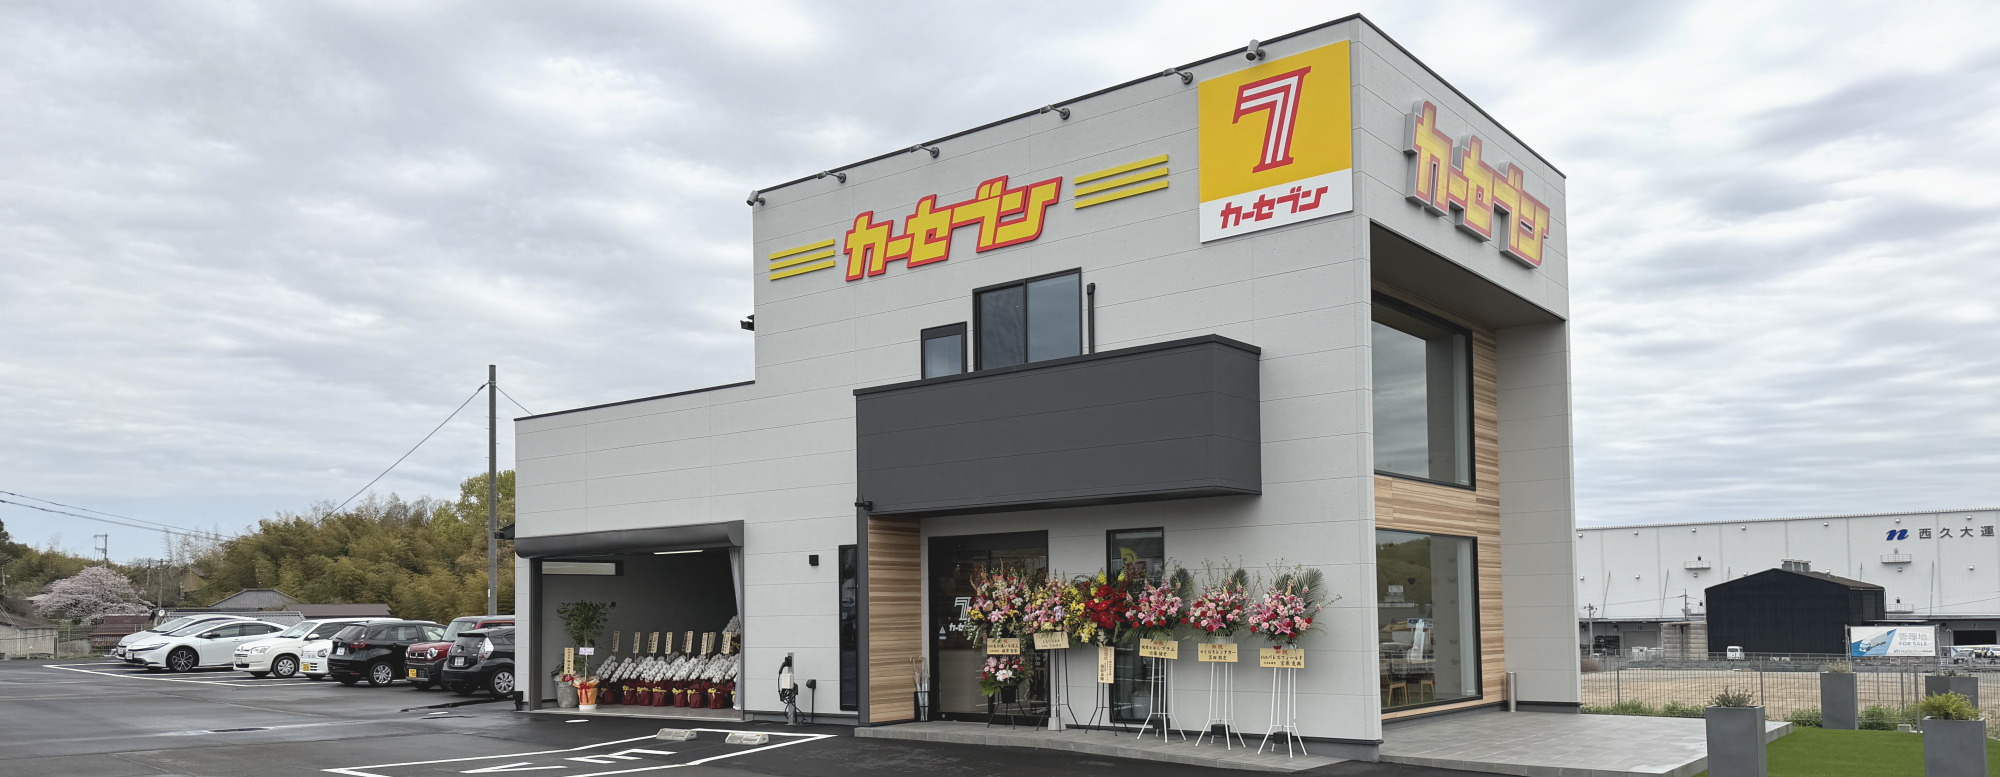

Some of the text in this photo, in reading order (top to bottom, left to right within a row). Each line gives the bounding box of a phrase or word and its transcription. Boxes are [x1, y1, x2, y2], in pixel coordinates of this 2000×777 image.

[1220, 185, 1329, 229] カーセブン
[1411, 100, 1551, 268] カーセブン
[843, 174, 1063, 282] カーセブン
[1919, 525, 1995, 540] 西久大運
